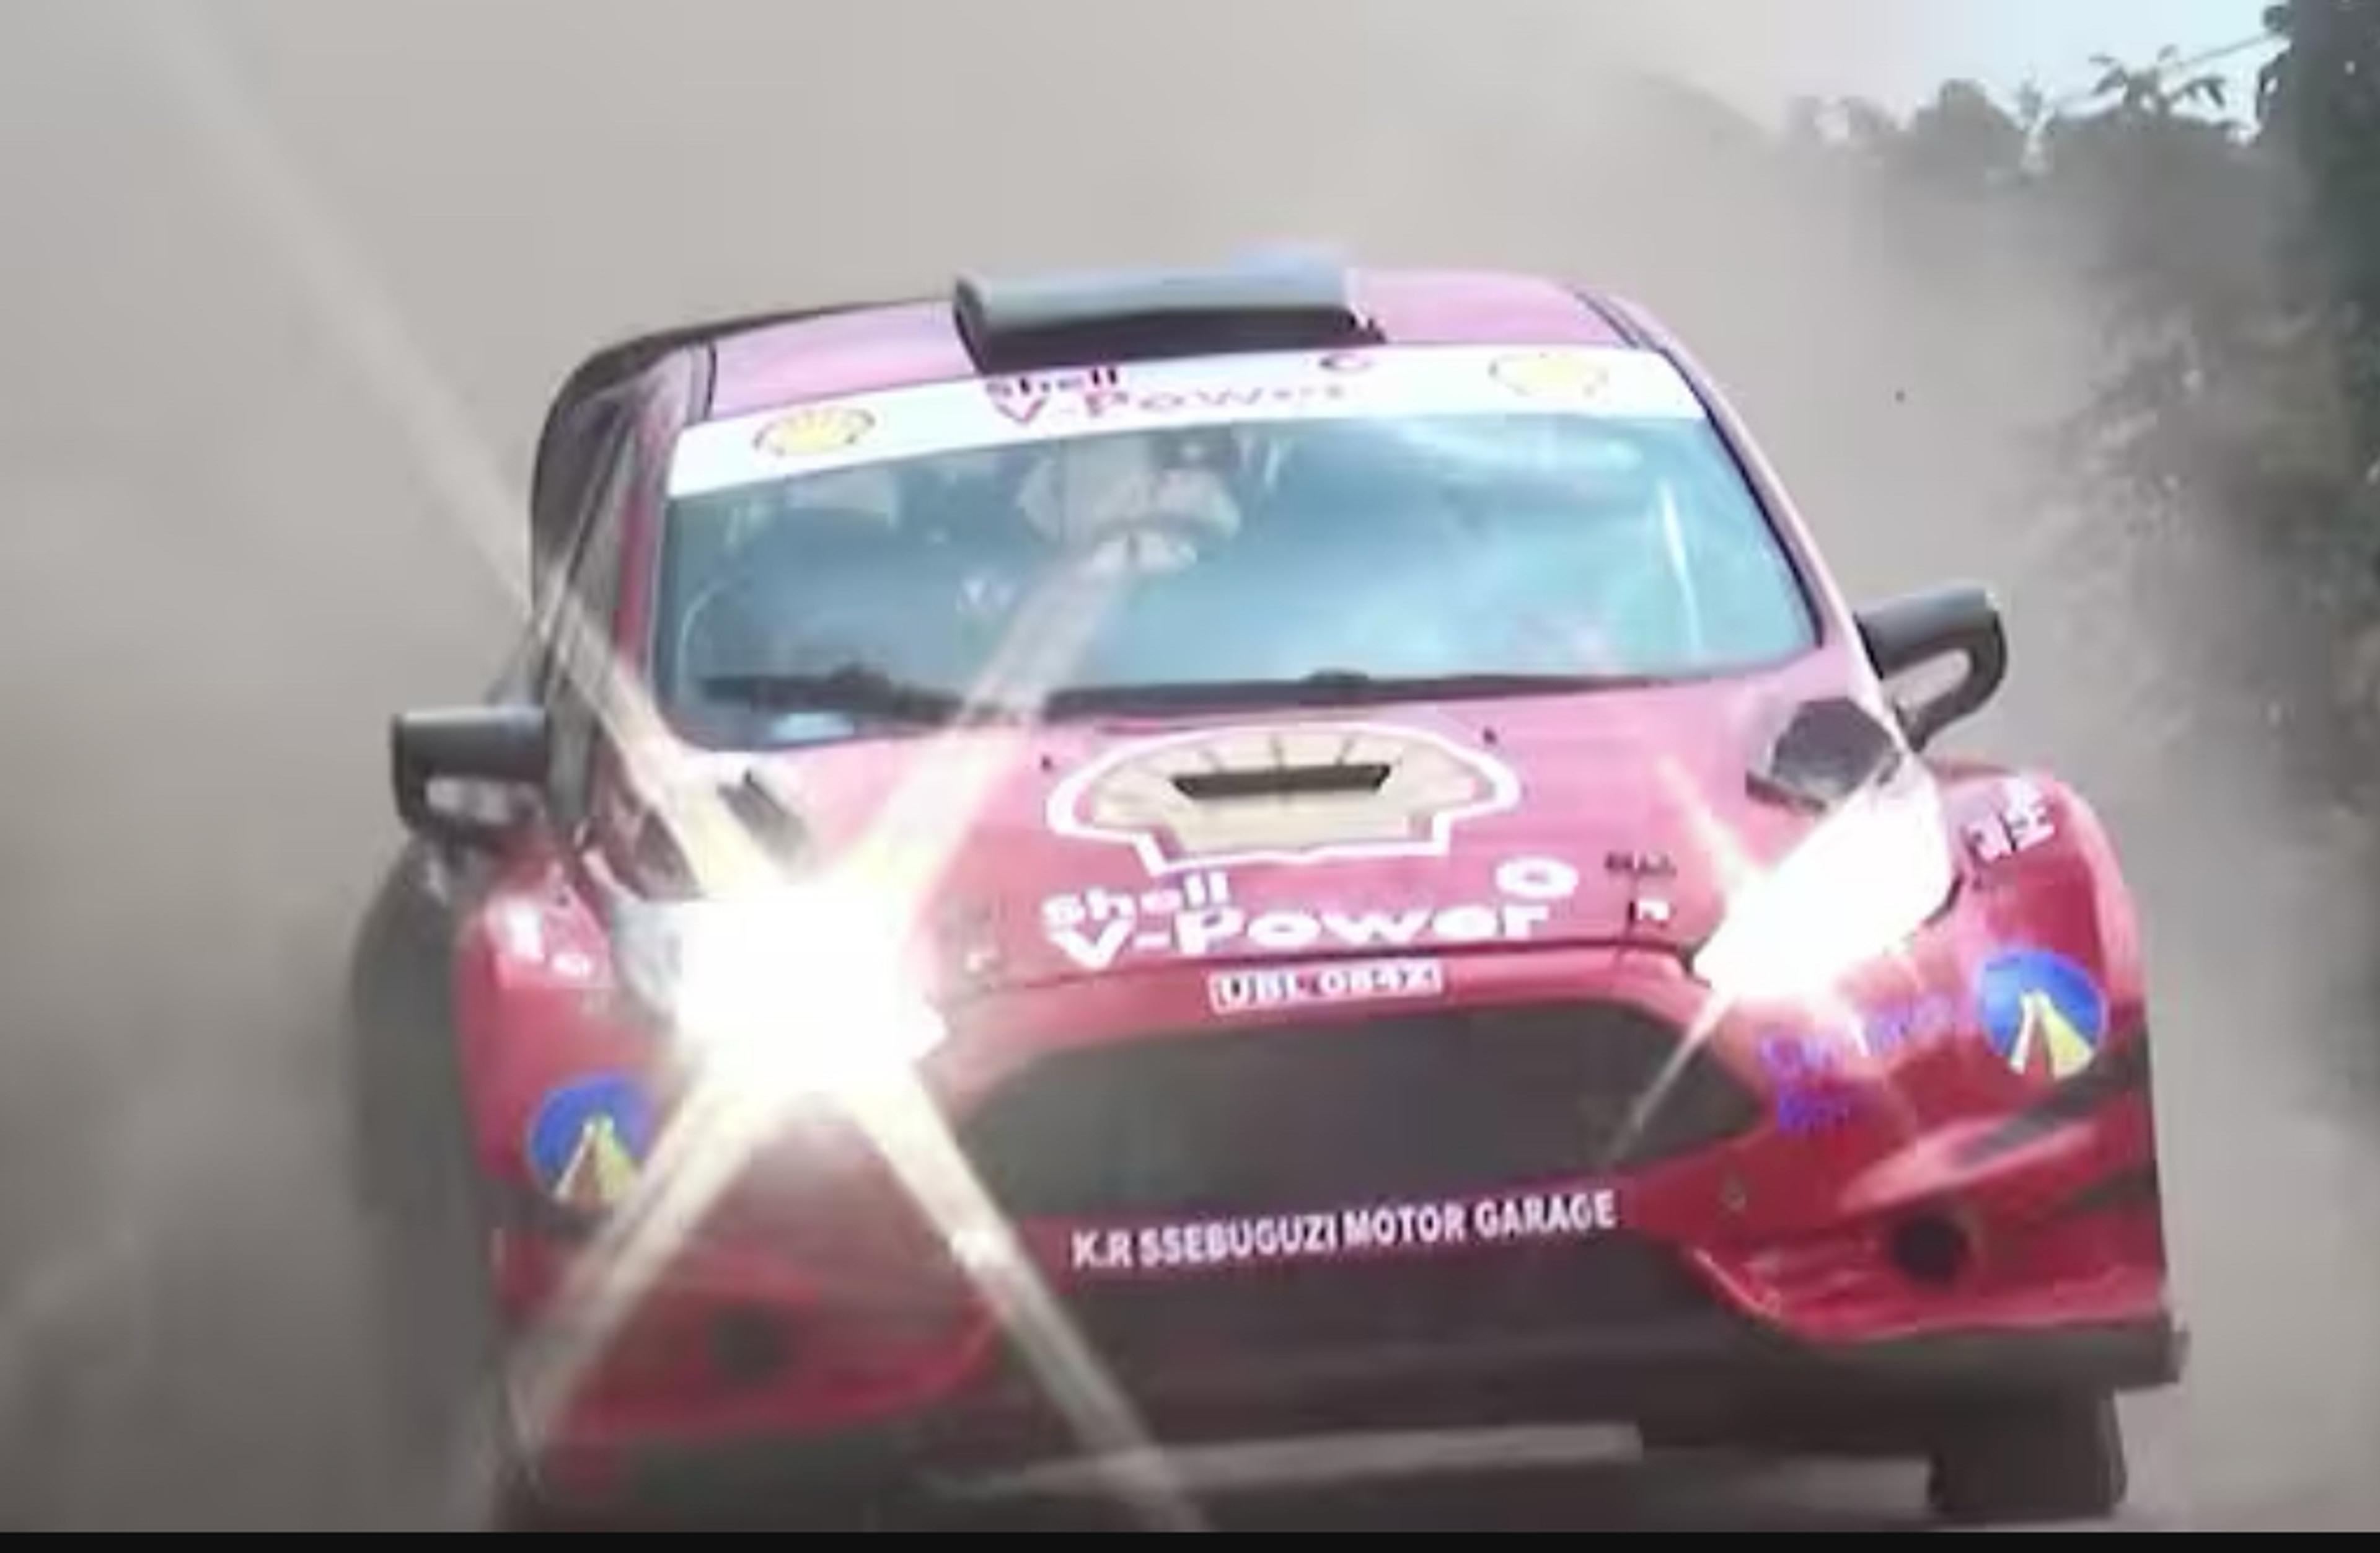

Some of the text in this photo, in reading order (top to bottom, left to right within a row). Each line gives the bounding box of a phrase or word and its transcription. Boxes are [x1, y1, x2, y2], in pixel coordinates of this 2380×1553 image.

[1045, 905, 1551, 969] V-Power
[1139, 1214, 1336, 1265] SSEBUGUZI
[1342, 1203, 1466, 1246] MOTOR
[1474, 1189, 1615, 1239] GARAGE
